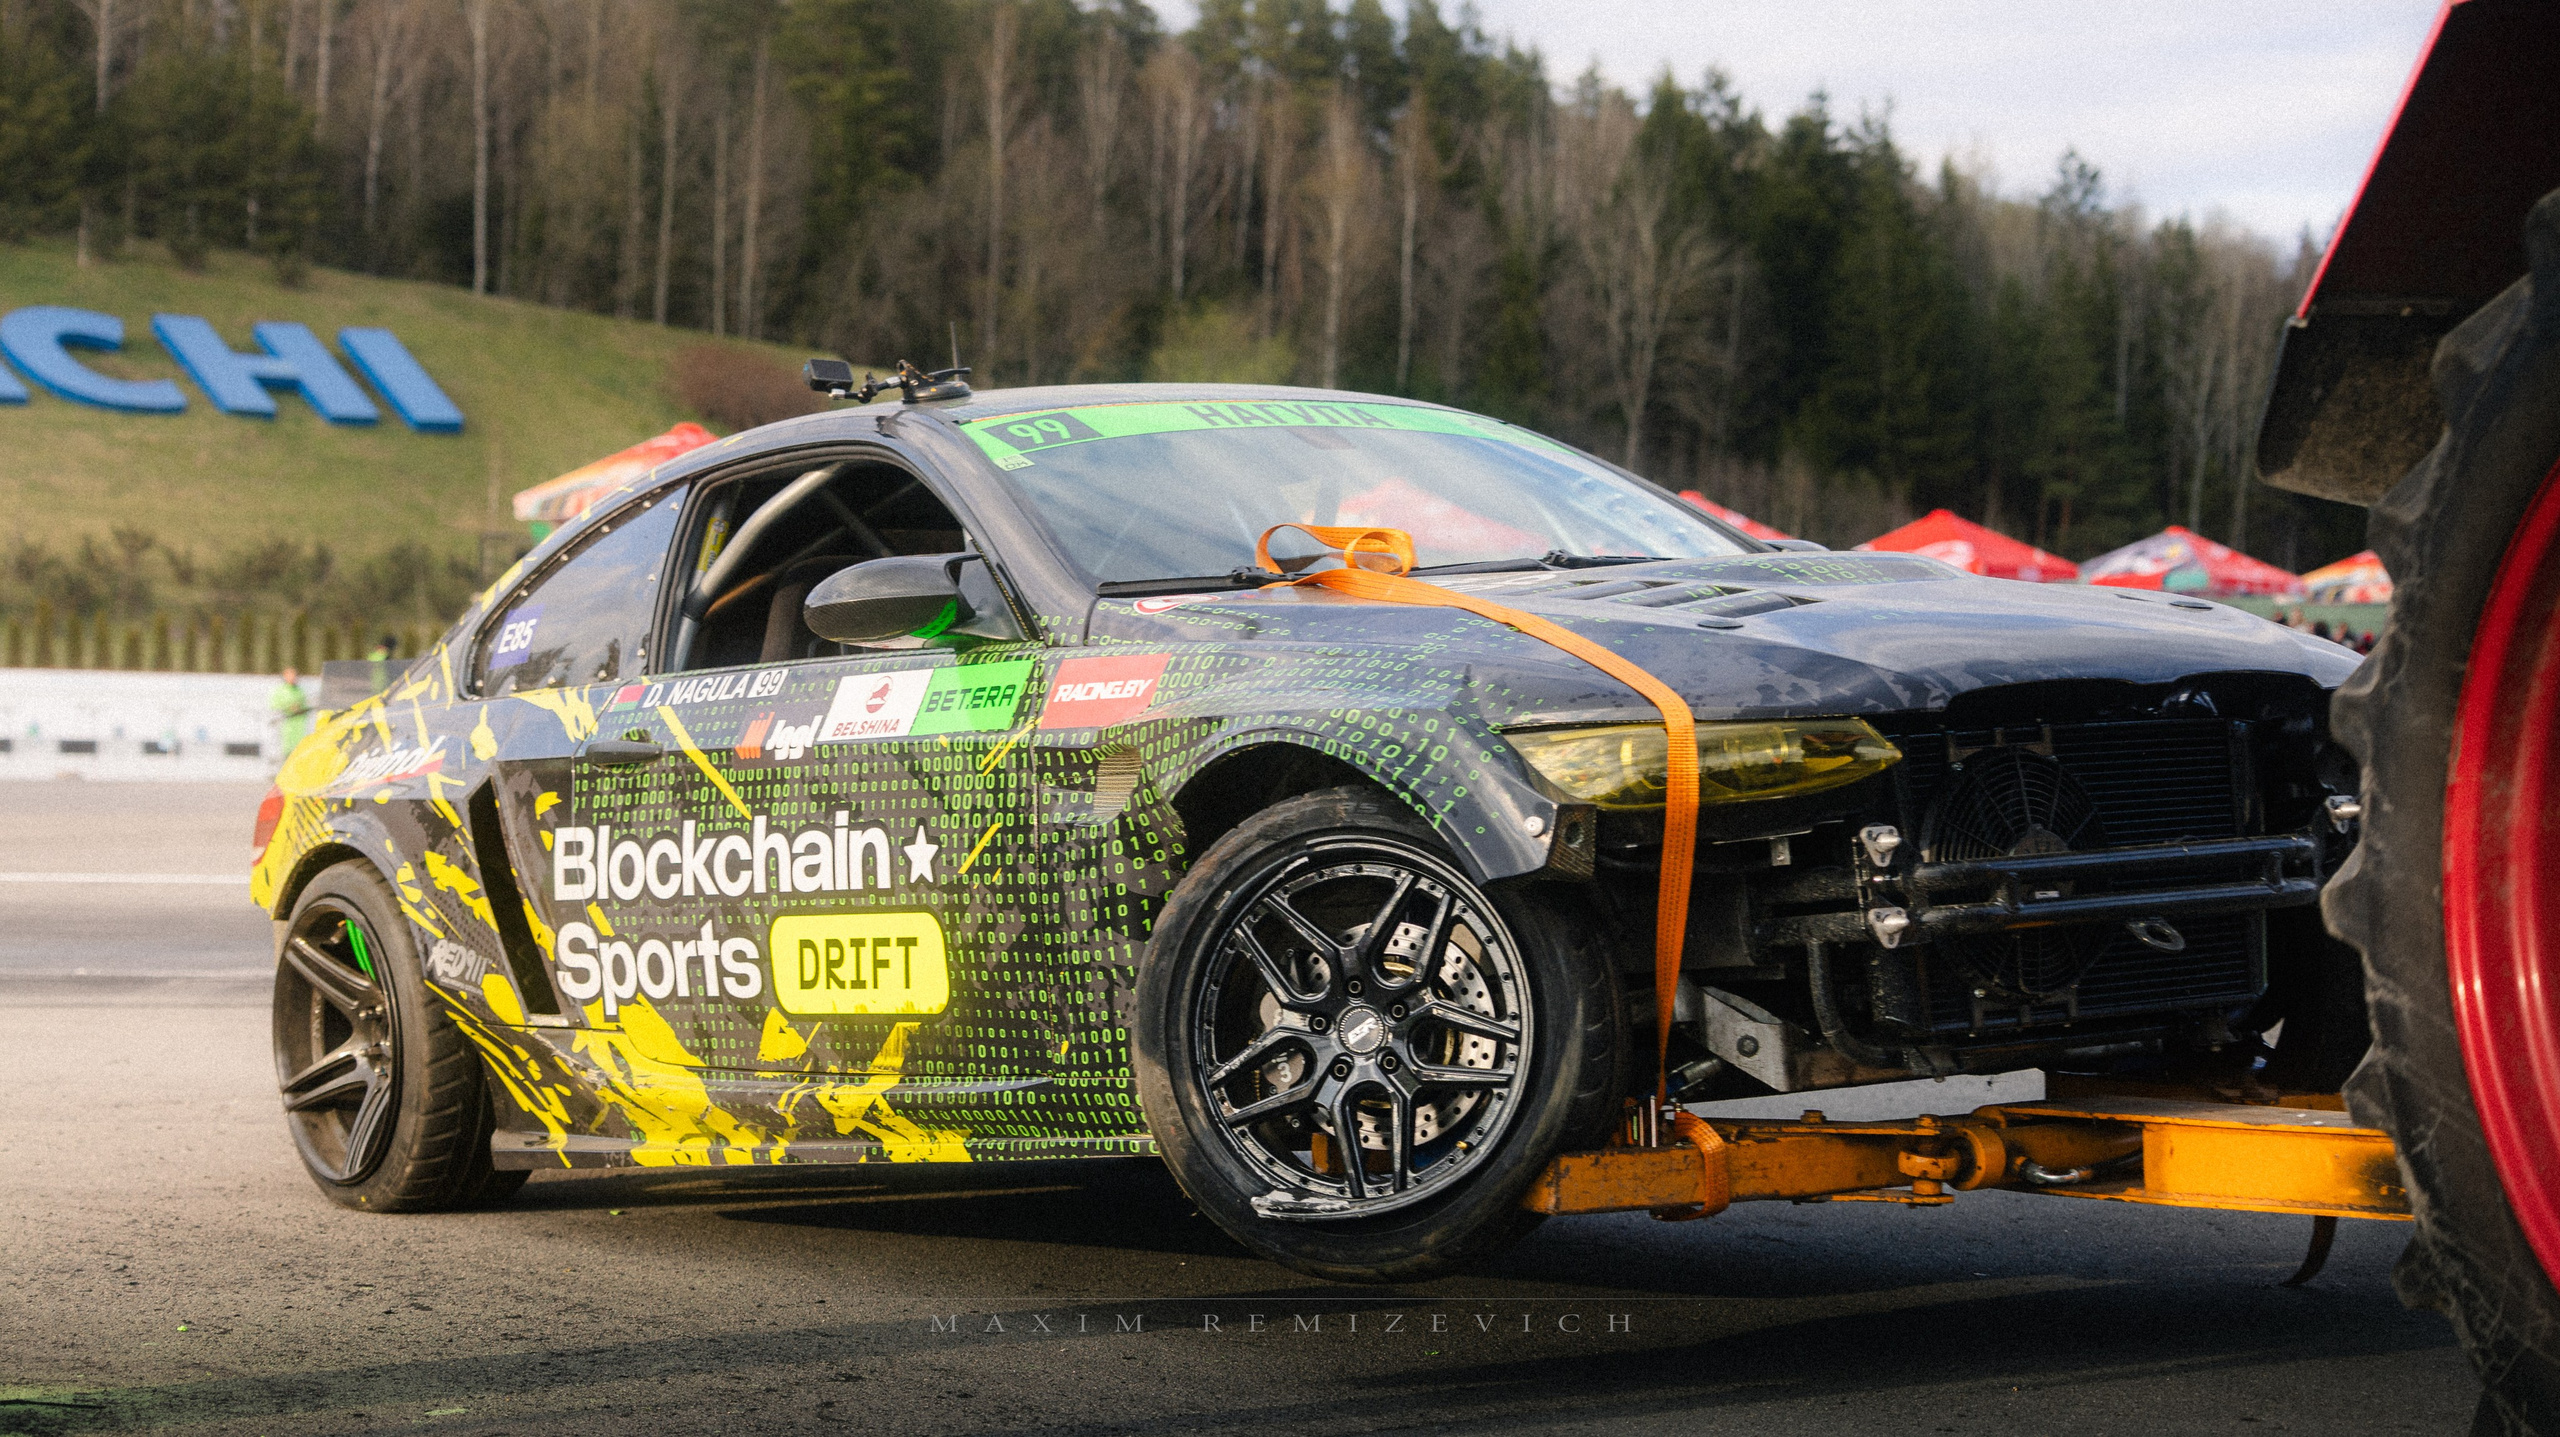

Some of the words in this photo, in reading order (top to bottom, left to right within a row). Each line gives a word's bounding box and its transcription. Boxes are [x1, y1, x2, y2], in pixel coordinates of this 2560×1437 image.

[0, 305, 465, 434] CHI
[1006, 418, 1071, 445] 99
[497, 618, 534, 656] E85
[642, 683, 664, 709] D.
[665, 673, 751, 707] NAGULA
[756, 669, 784, 696] 99
[832, 718, 900, 737] BELSHINA
[553, 810, 892, 902] Blockchain
[556, 919, 763, 1017] Sports
[799, 936, 919, 990] DRIFT
